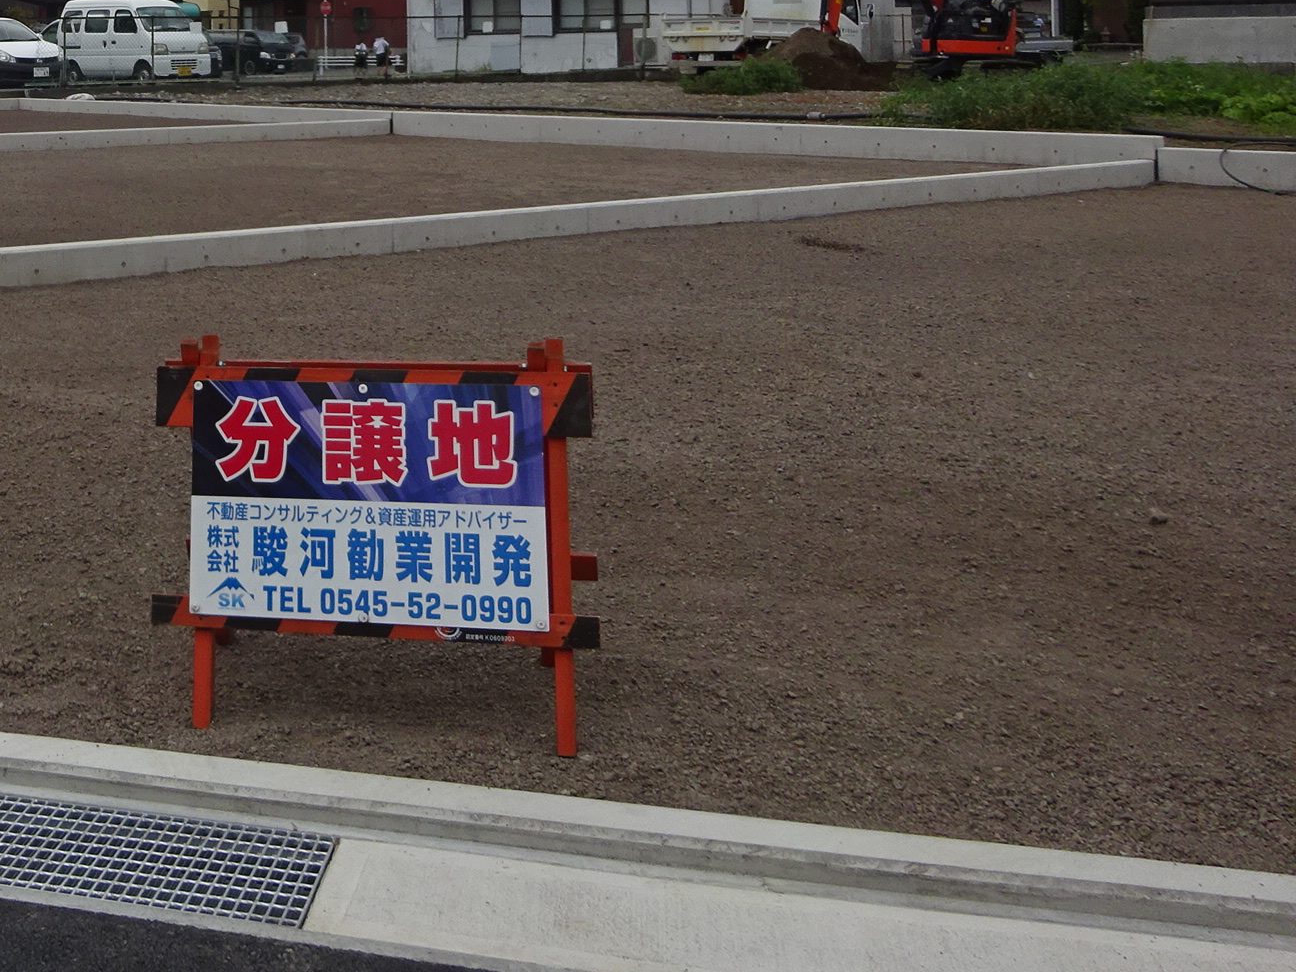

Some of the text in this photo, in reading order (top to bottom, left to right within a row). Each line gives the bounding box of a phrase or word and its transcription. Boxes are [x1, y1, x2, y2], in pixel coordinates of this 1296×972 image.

[215, 395, 518, 488] 分譲地
[206, 524, 240, 549] 株式
[206, 549, 240, 573] 会社
[251, 525, 533, 588] 駿河勧業開発
[217, 592, 246, 609] SK
[262, 585, 533, 625] TEL 0545-52-0990
